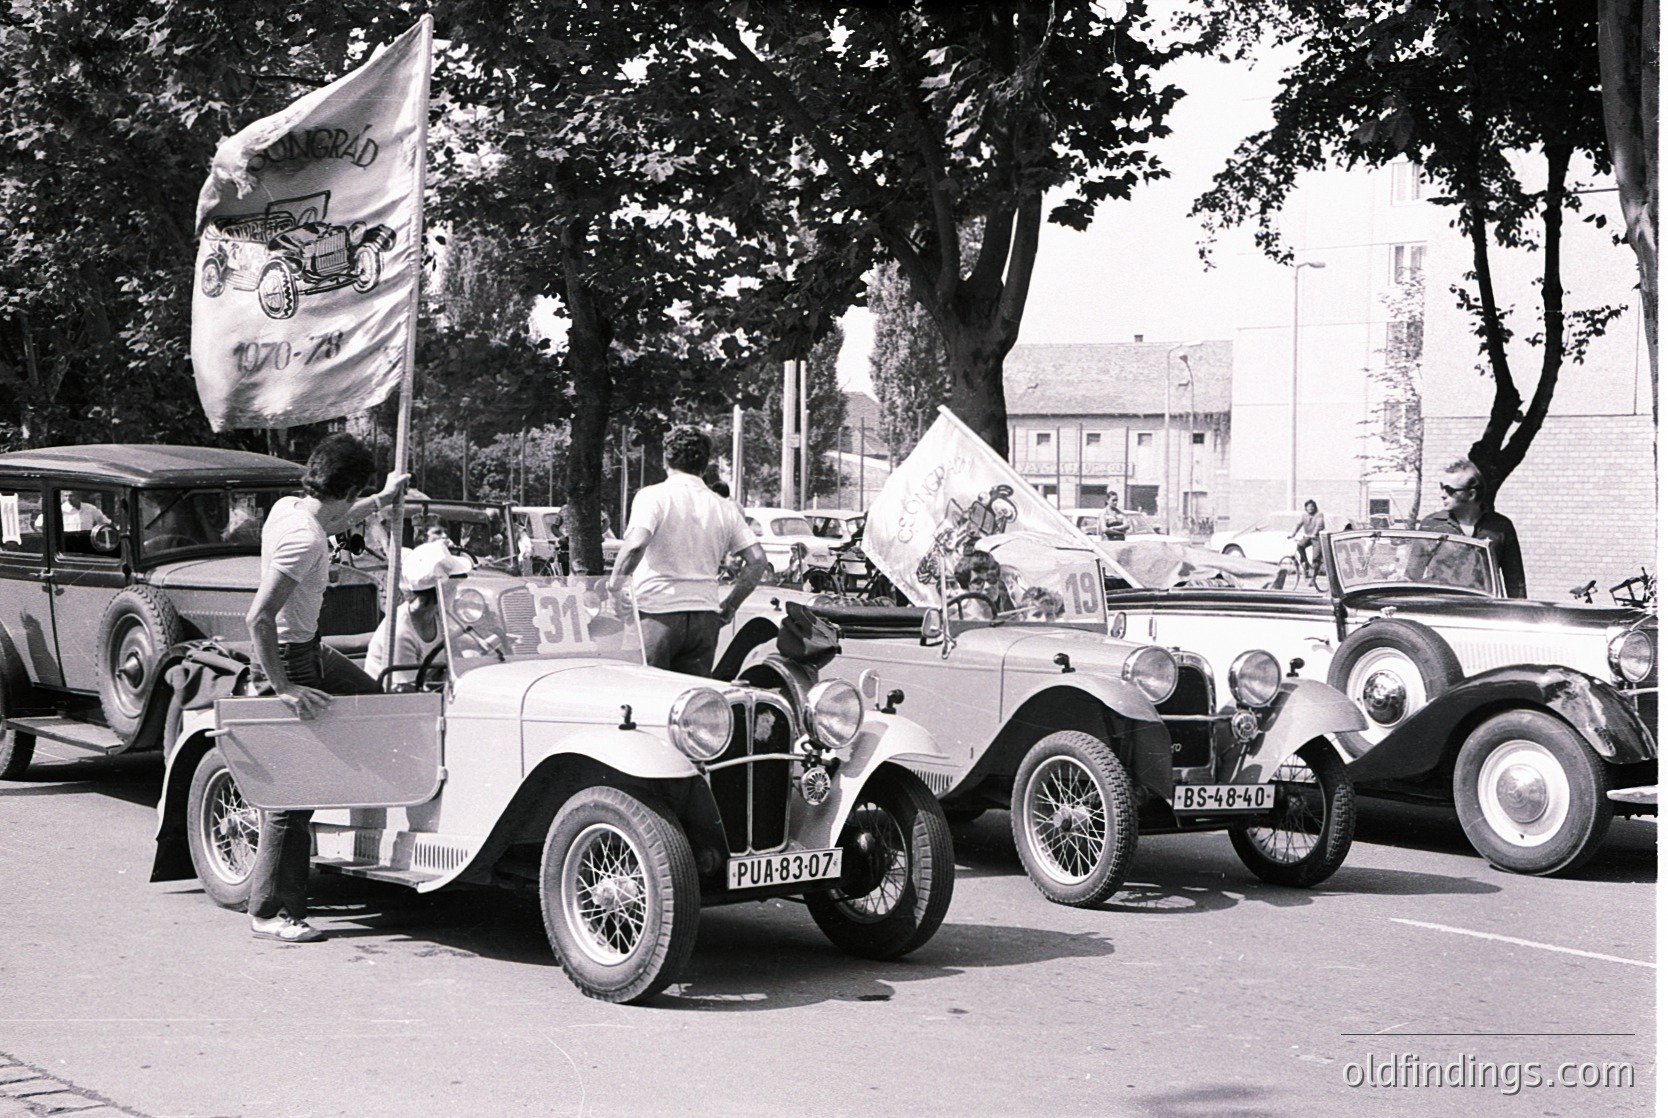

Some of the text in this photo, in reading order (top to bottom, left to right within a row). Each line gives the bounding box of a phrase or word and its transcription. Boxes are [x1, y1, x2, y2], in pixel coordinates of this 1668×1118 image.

[1065, 572, 1098, 615] 19
[540, 595, 583, 644] 31
[1183, 787, 1265, 808] BS-48-40
